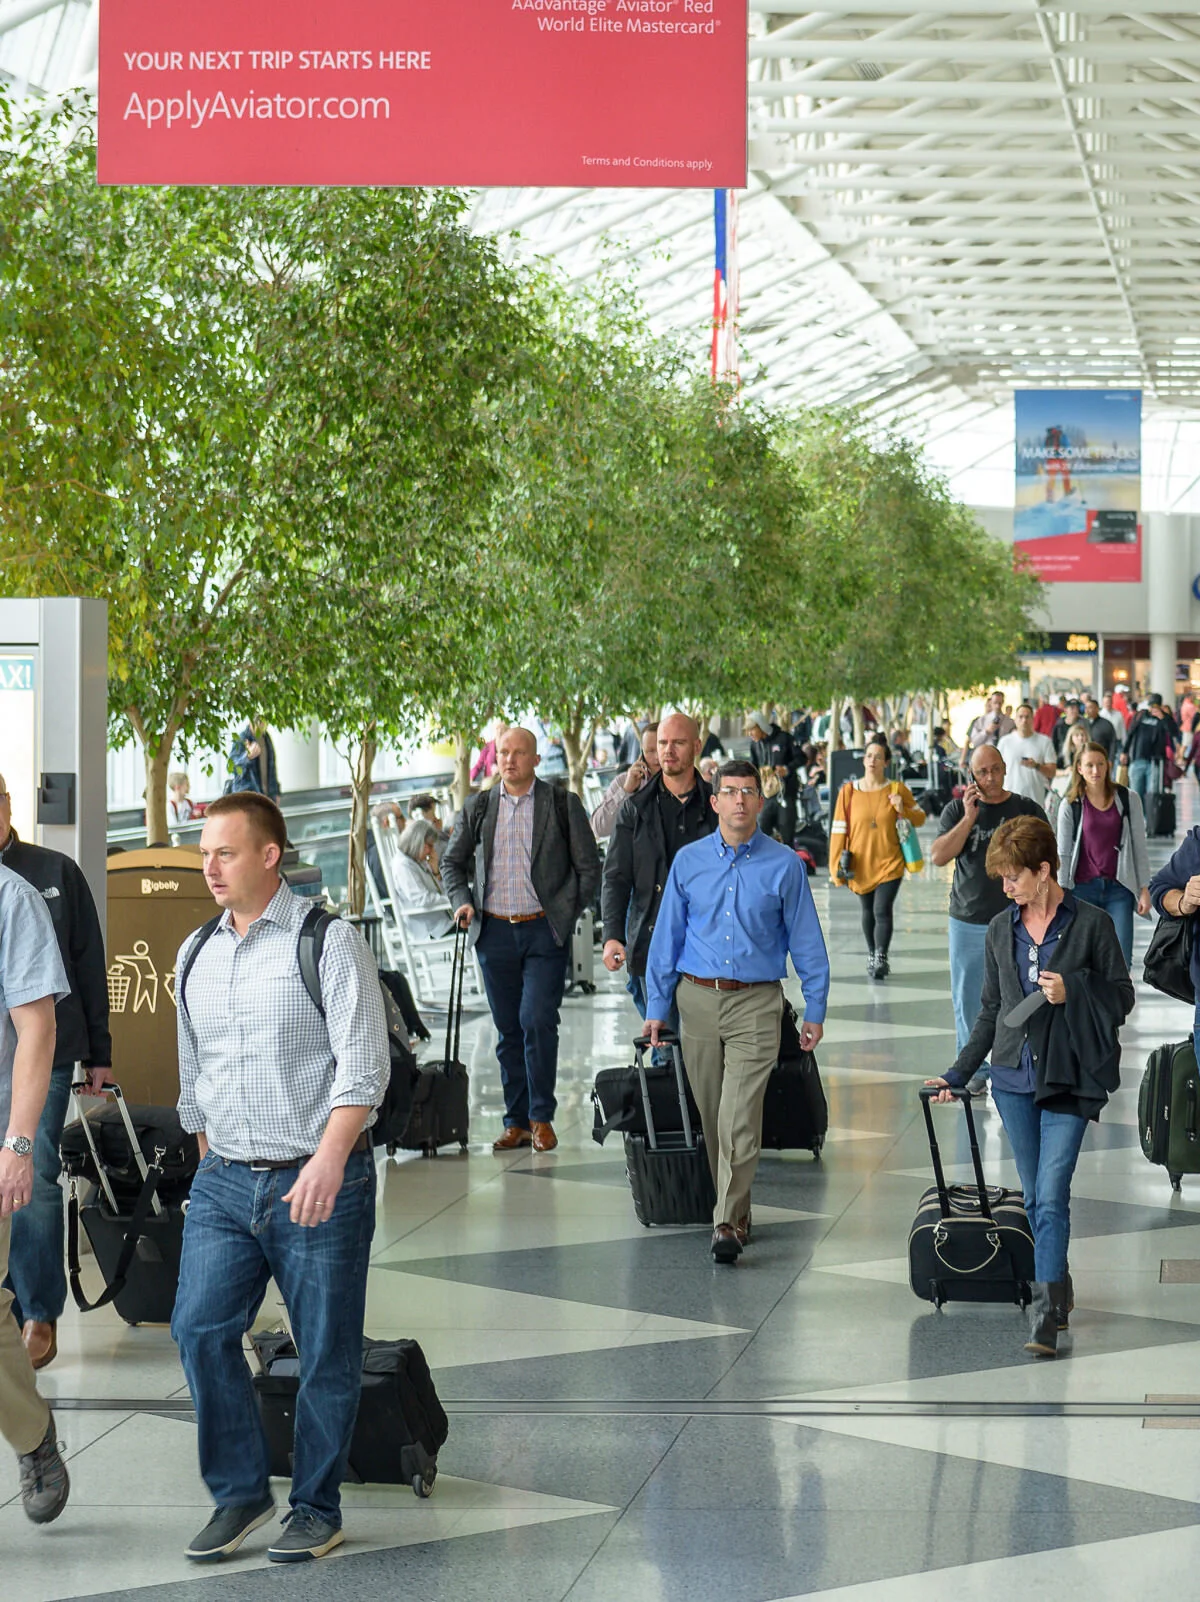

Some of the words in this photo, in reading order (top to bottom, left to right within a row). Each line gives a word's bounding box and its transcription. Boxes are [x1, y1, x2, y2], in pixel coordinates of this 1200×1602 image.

[684, 0, 713, 13] Red
[537, 17, 584, 32] World
[590, 17, 623, 33] Elite
[123, 52, 183, 70] YOUR
[189, 51, 244, 70] NEXT
[248, 51, 293, 70] TRIP
[299, 51, 373, 69] STARTS
[379, 51, 431, 69] HERE
[123, 89, 390, 128] ApplyAviator.com
[582, 155, 610, 166] Terms
[612, 156, 631, 167] and
[633, 156, 684, 168] Conditions
[1023, 447, 1058, 459] MAKE
[1059, 447, 1089, 459] SOME
[1091, 447, 1138, 460] TRACKS
[141, 878, 179, 894] Bigbelly
